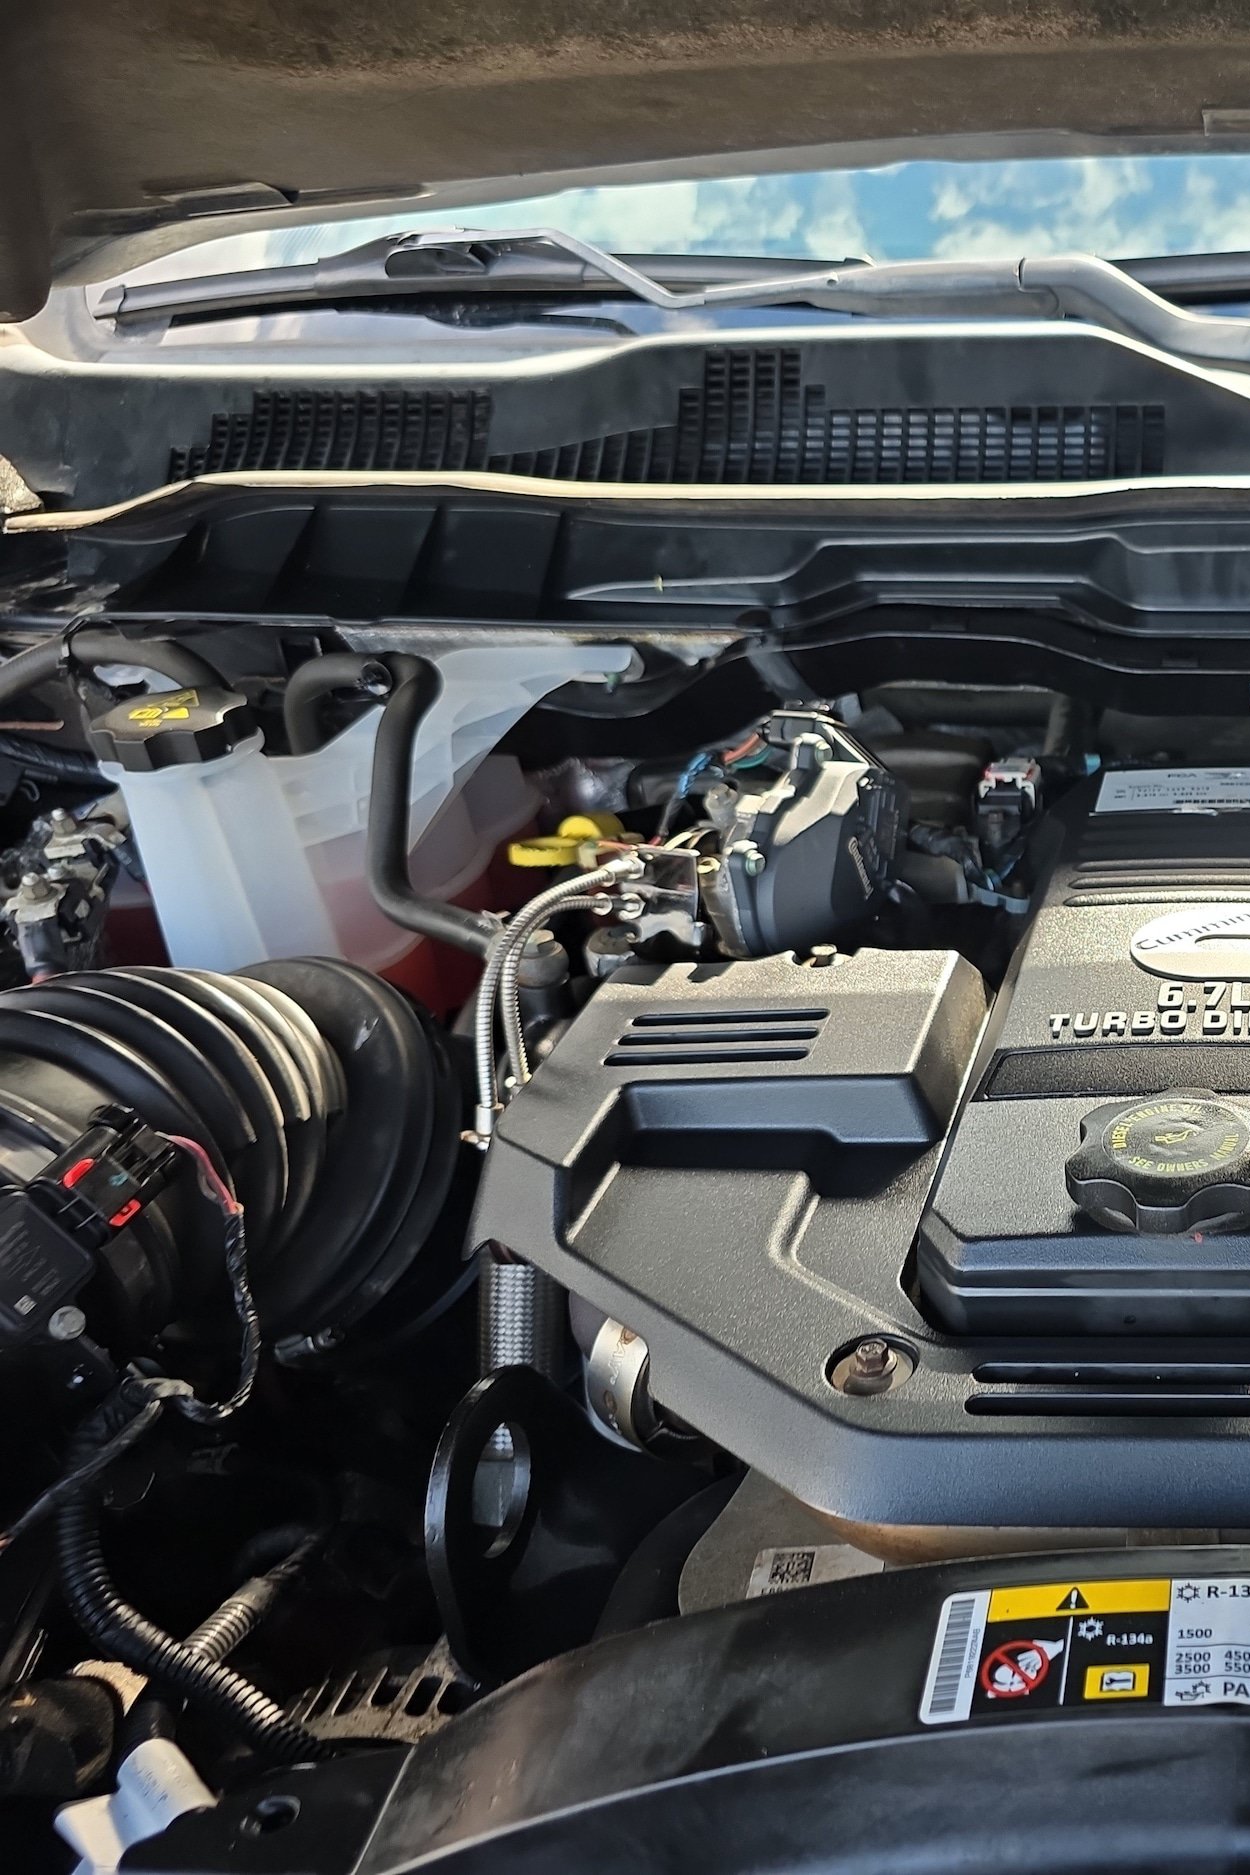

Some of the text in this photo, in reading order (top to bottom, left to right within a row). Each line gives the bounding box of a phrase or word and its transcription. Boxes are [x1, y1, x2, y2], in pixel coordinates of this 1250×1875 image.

[1157, 981, 1250, 1013] 6.7L
[1050, 1009, 1187, 1039] TURBO
[1124, 1104, 1177, 1122] ENGINE
[1128, 1156, 1155, 1170] SEE
[1156, 1159, 1209, 1172] OWNERS
[1106, 1633, 1153, 1647] R-134a
[1177, 1628, 1213, 1639] 1500
[1175, 1652, 1212, 1664] 2500
[1174, 1664, 1211, 1675] 3500
